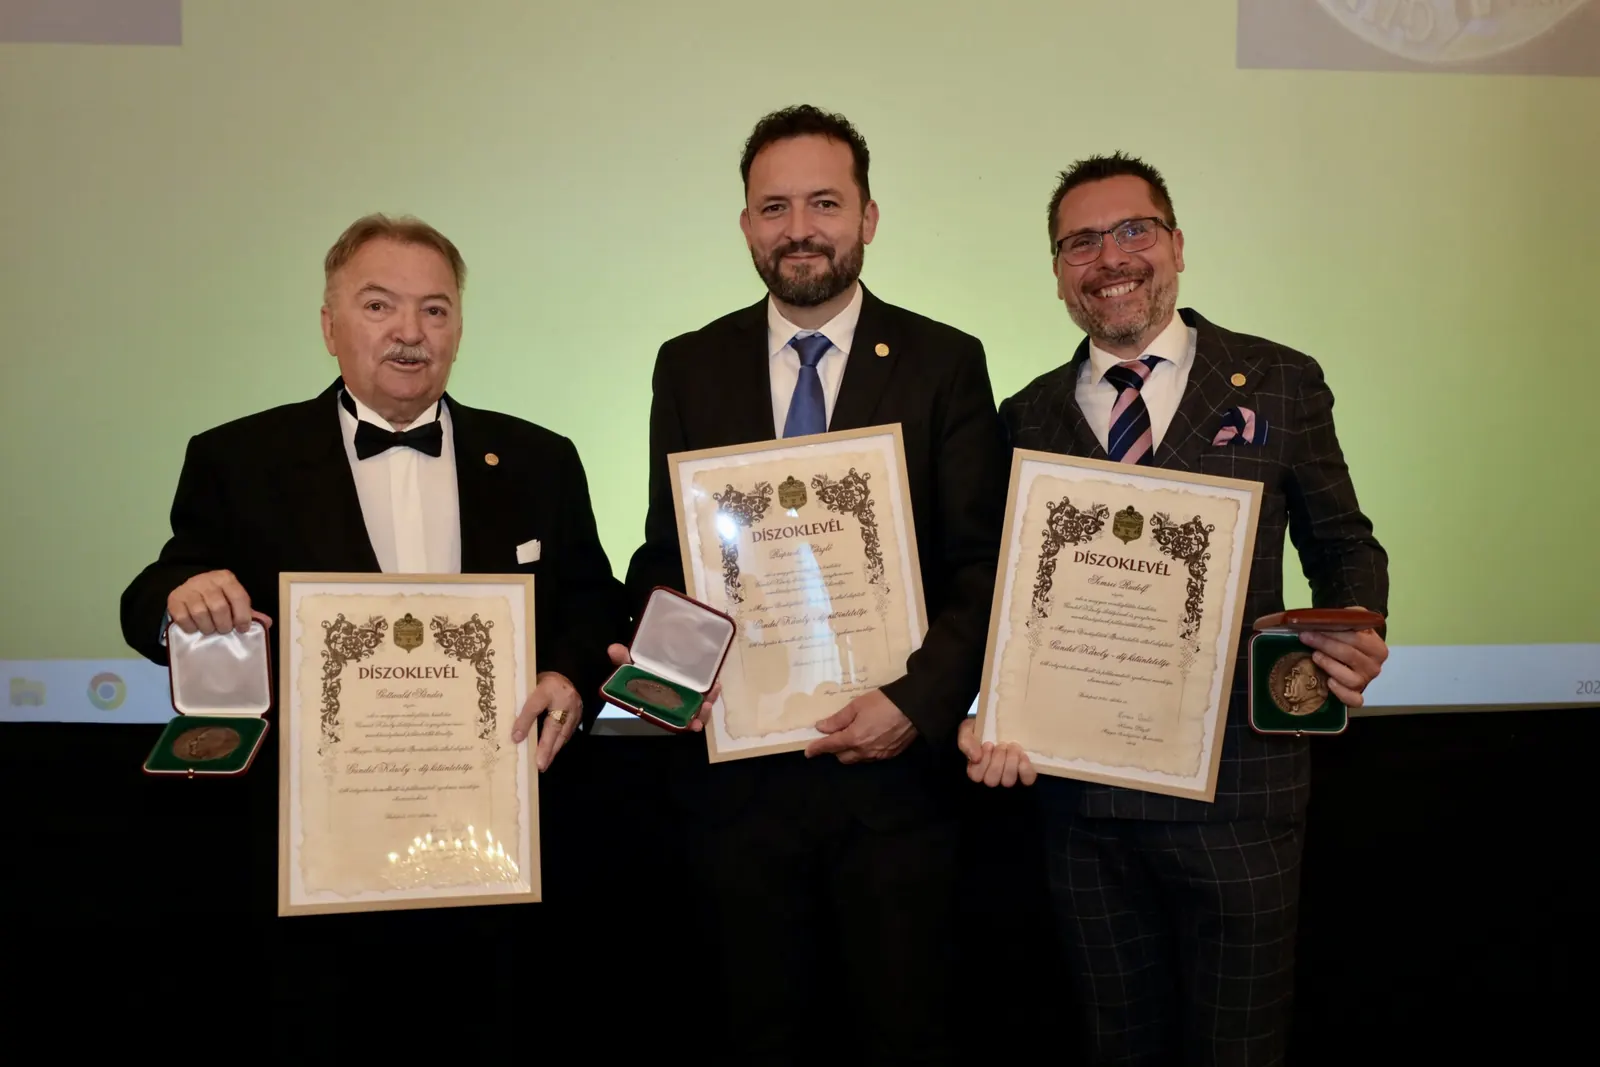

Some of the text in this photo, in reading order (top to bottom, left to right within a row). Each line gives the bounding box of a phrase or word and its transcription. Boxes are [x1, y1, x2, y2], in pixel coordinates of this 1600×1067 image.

[752, 518, 844, 543] DÍSZOKLEVÉL
[1073, 550, 1171, 577] DÍSZOKLEVÉL
[1118, 579, 1152, 594] Rudolf
[1050, 640, 1079, 652] Gundel
[1079, 644, 1109, 660] Károly
[358, 664, 460, 680] DÍSZOKLEVÉL
